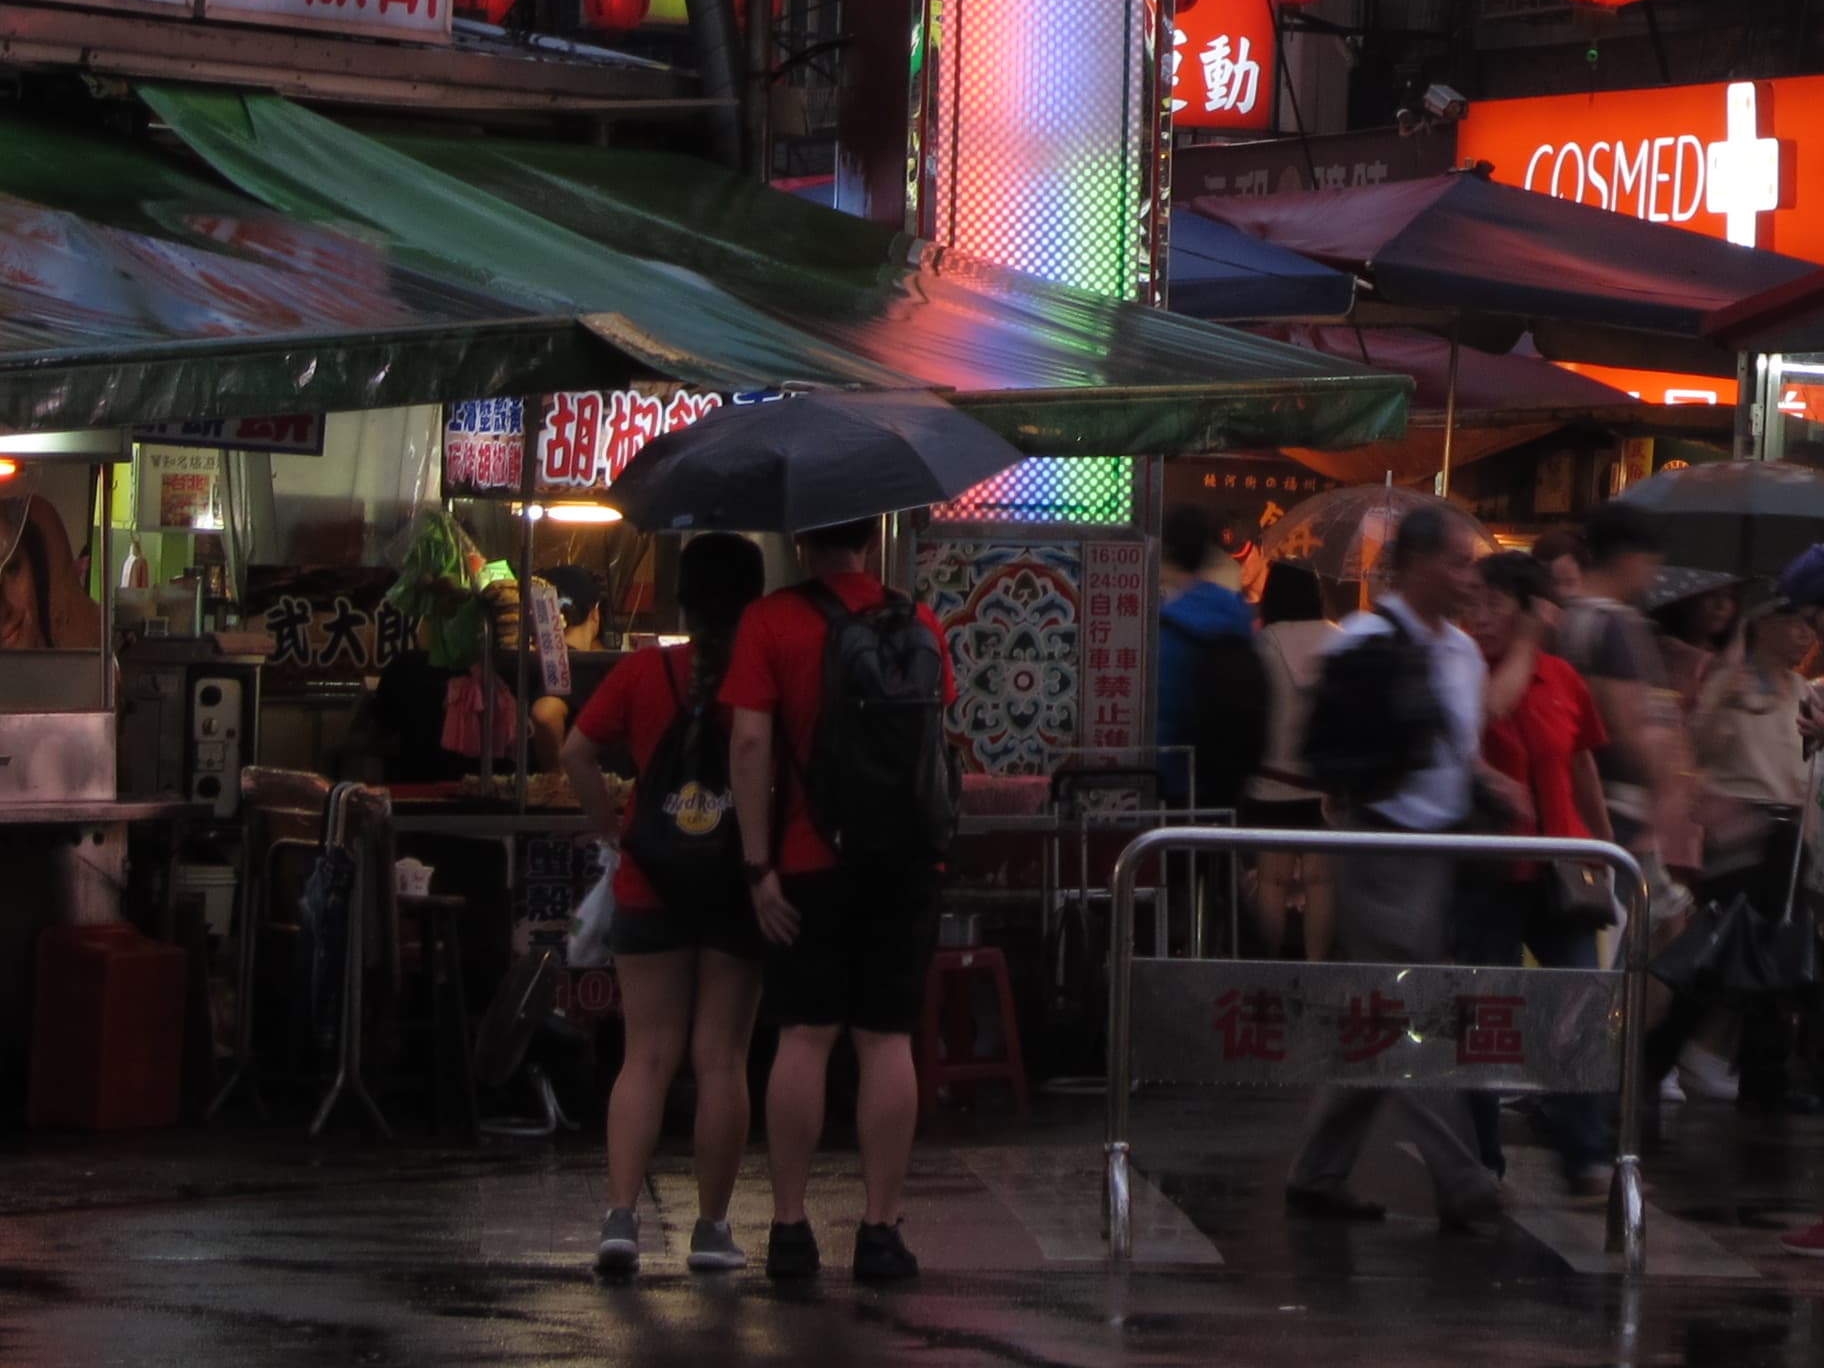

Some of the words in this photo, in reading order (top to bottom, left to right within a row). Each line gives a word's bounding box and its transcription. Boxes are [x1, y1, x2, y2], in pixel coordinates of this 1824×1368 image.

[1525, 135, 1704, 223] COSMED
[1090, 548, 1140, 564] 16:00
[1089, 574, 1140, 590] 24:00
[1213, 989, 1527, 1065] 徒步區
